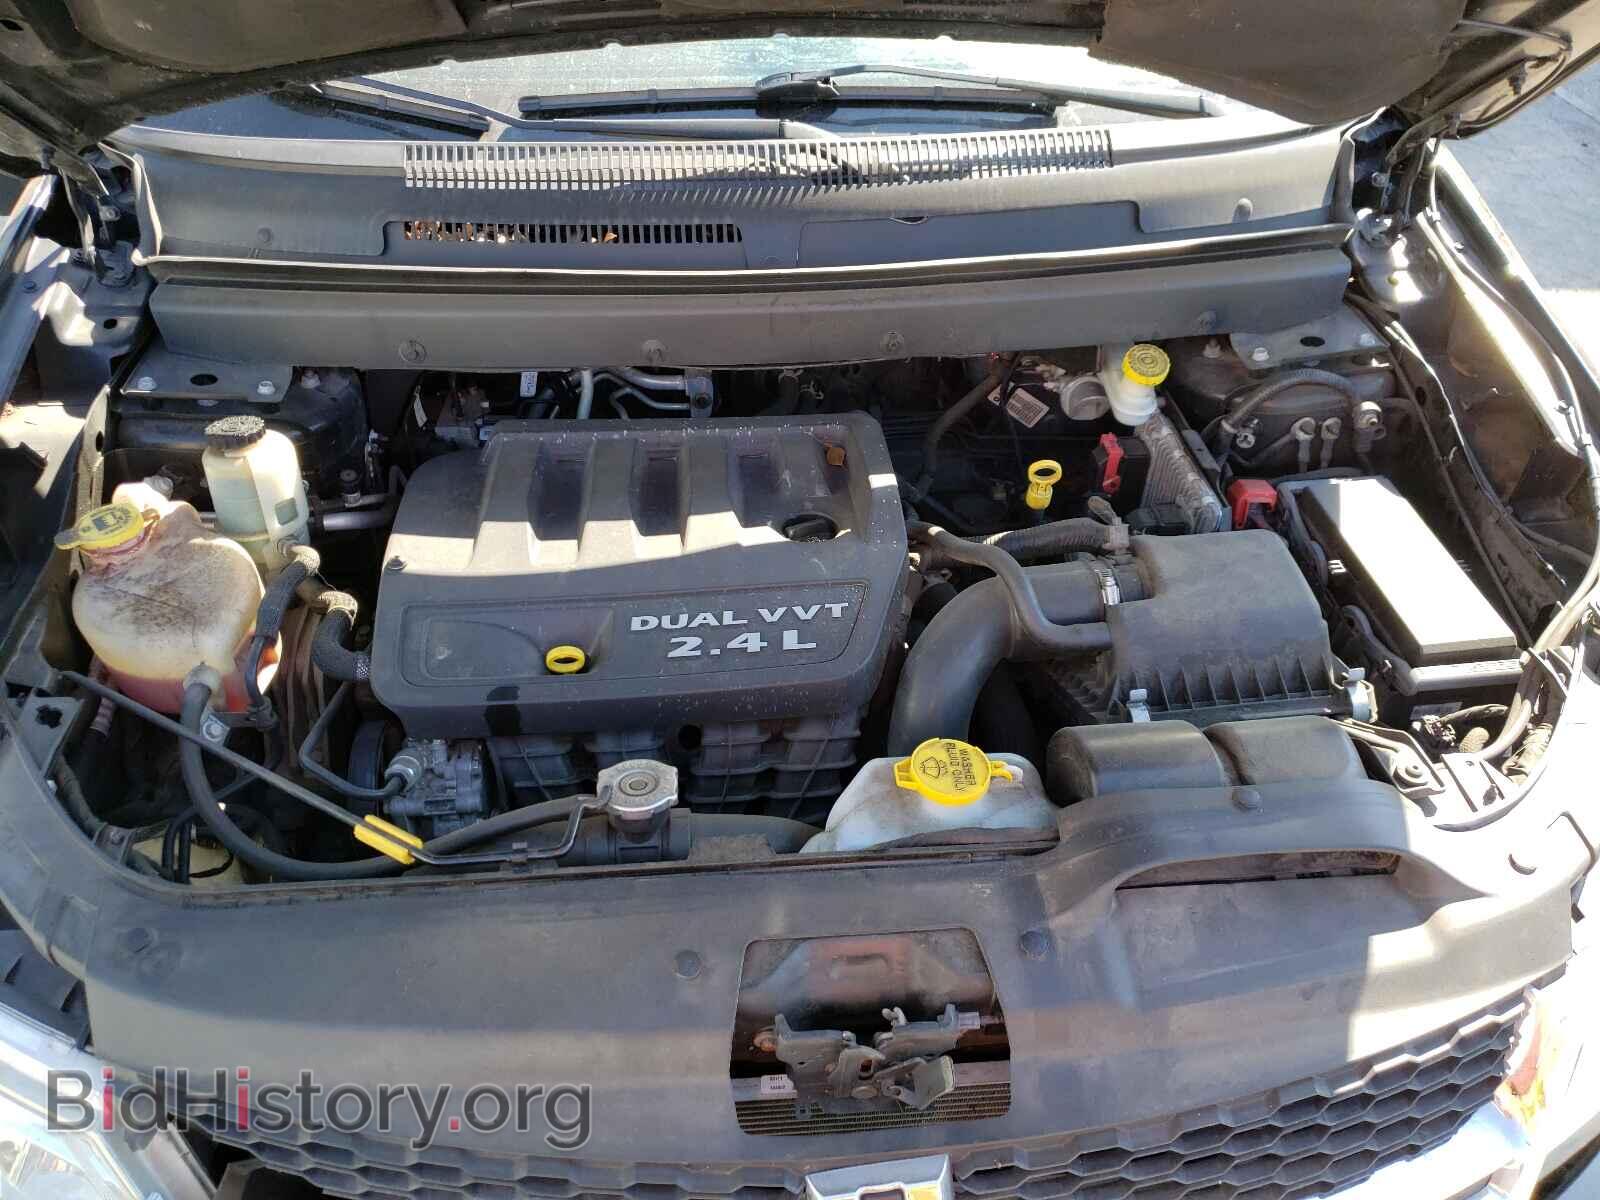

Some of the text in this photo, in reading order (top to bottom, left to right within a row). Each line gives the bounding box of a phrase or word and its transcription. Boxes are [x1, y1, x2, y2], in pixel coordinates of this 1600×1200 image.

[631, 602, 849, 631] DUAL VVT
[667, 629, 817, 658] 2.4 L
[944, 742, 968, 792] FLUID ONLY
[959, 748, 977, 786] WASHER
